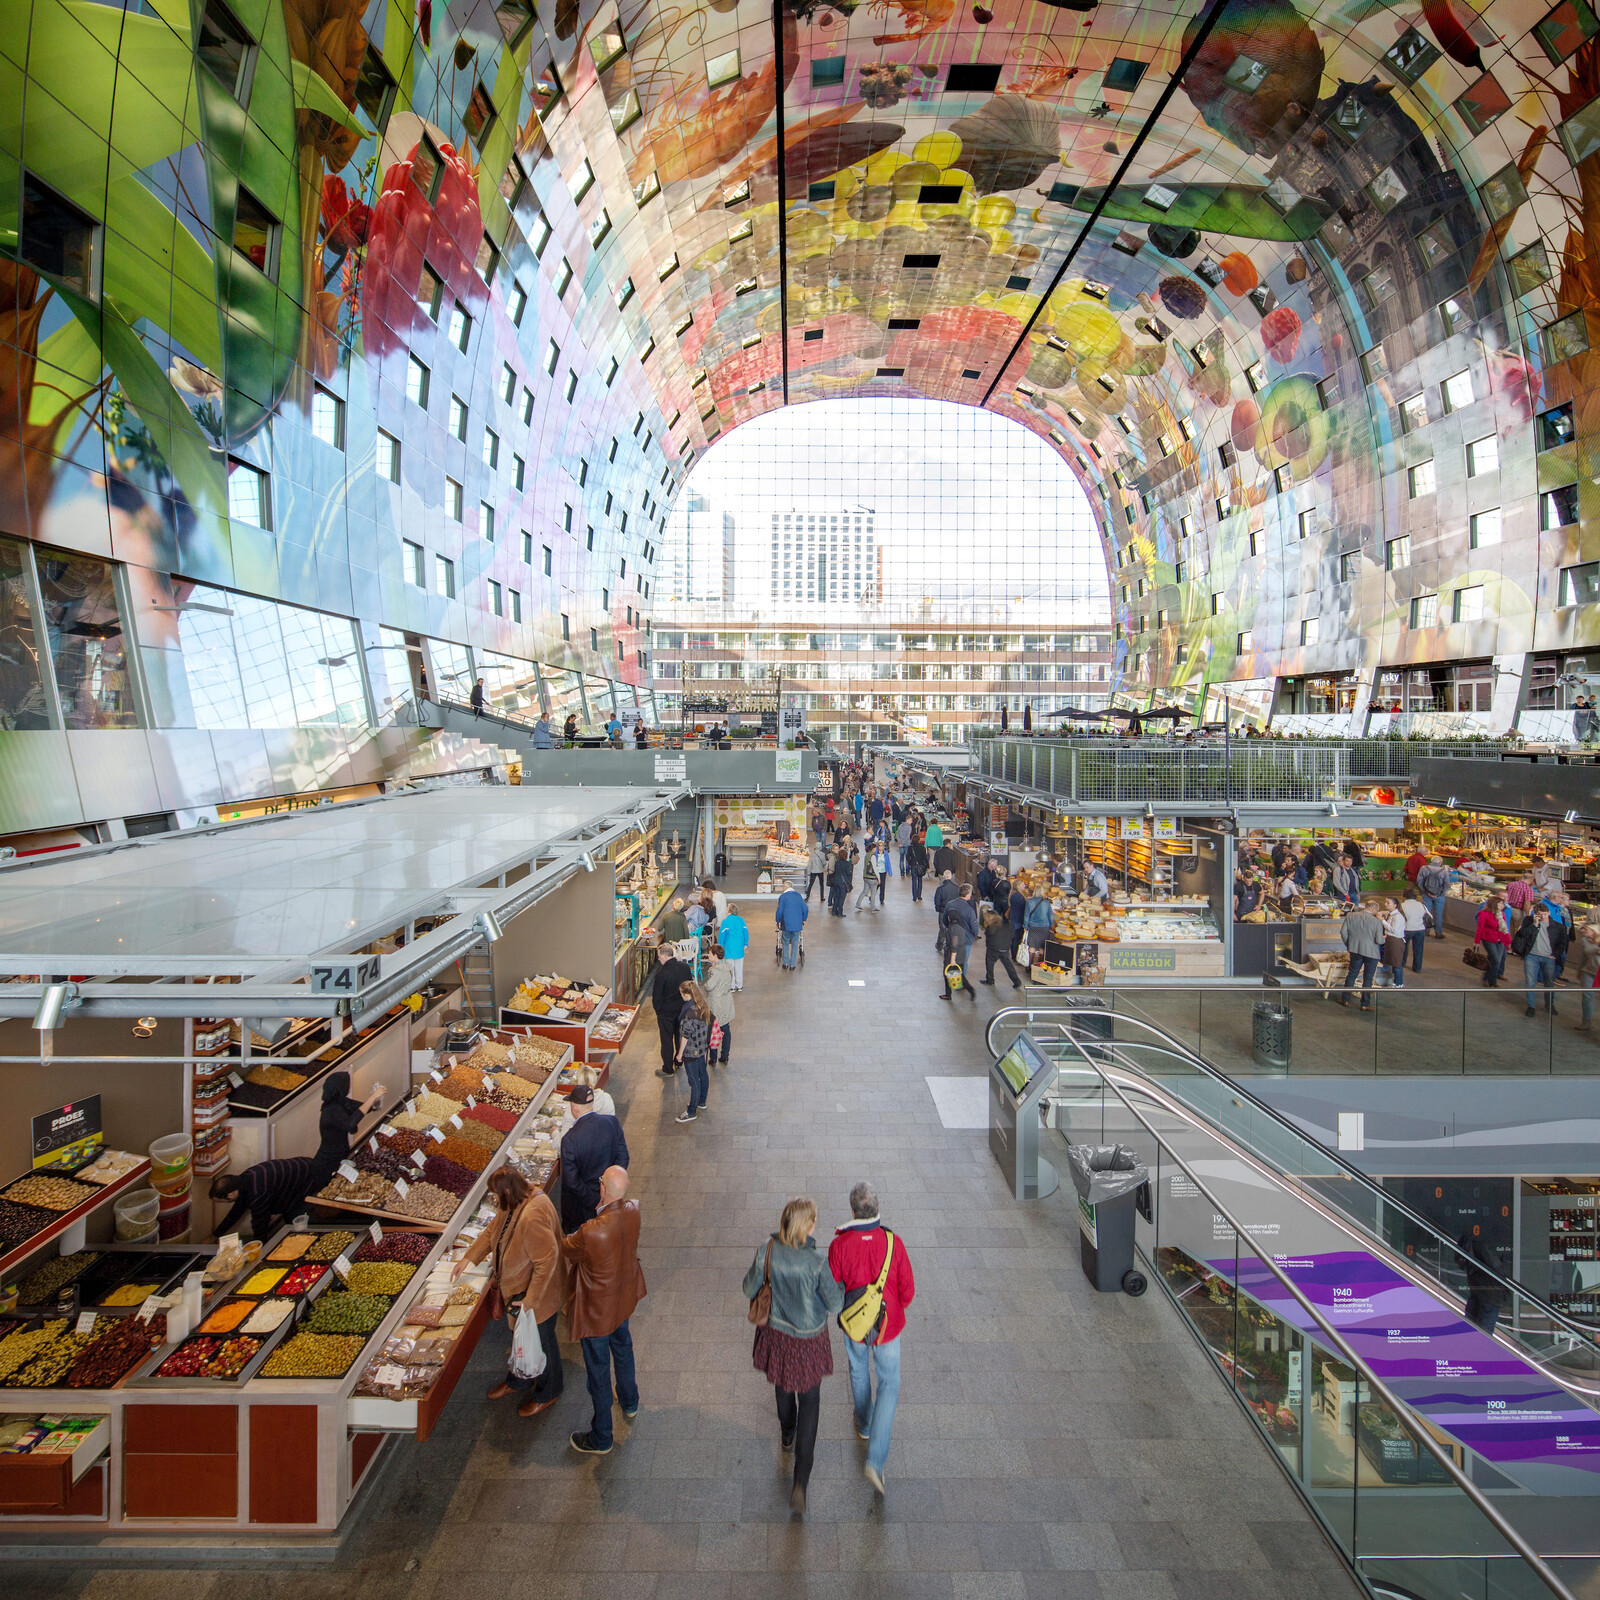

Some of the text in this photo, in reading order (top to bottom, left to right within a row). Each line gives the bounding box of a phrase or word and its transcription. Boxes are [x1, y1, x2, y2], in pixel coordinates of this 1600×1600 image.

[1313, 679, 1331, 687] Wine
[1113, 958, 1172, 967] KAASDOK
[358, 958, 379, 986] 74
[314, 968, 352, 989] 74
[51, 1109, 84, 1128] PROEF
[1435, 1187, 1442, 1198] G
[1577, 1197, 1595, 1207] Gall
[1501, 1206, 1509, 1217] G
[1473, 1225, 1480, 1236] G
[1406, 1245, 1414, 1256] G
[1332, 1288, 1352, 1297] 1940
